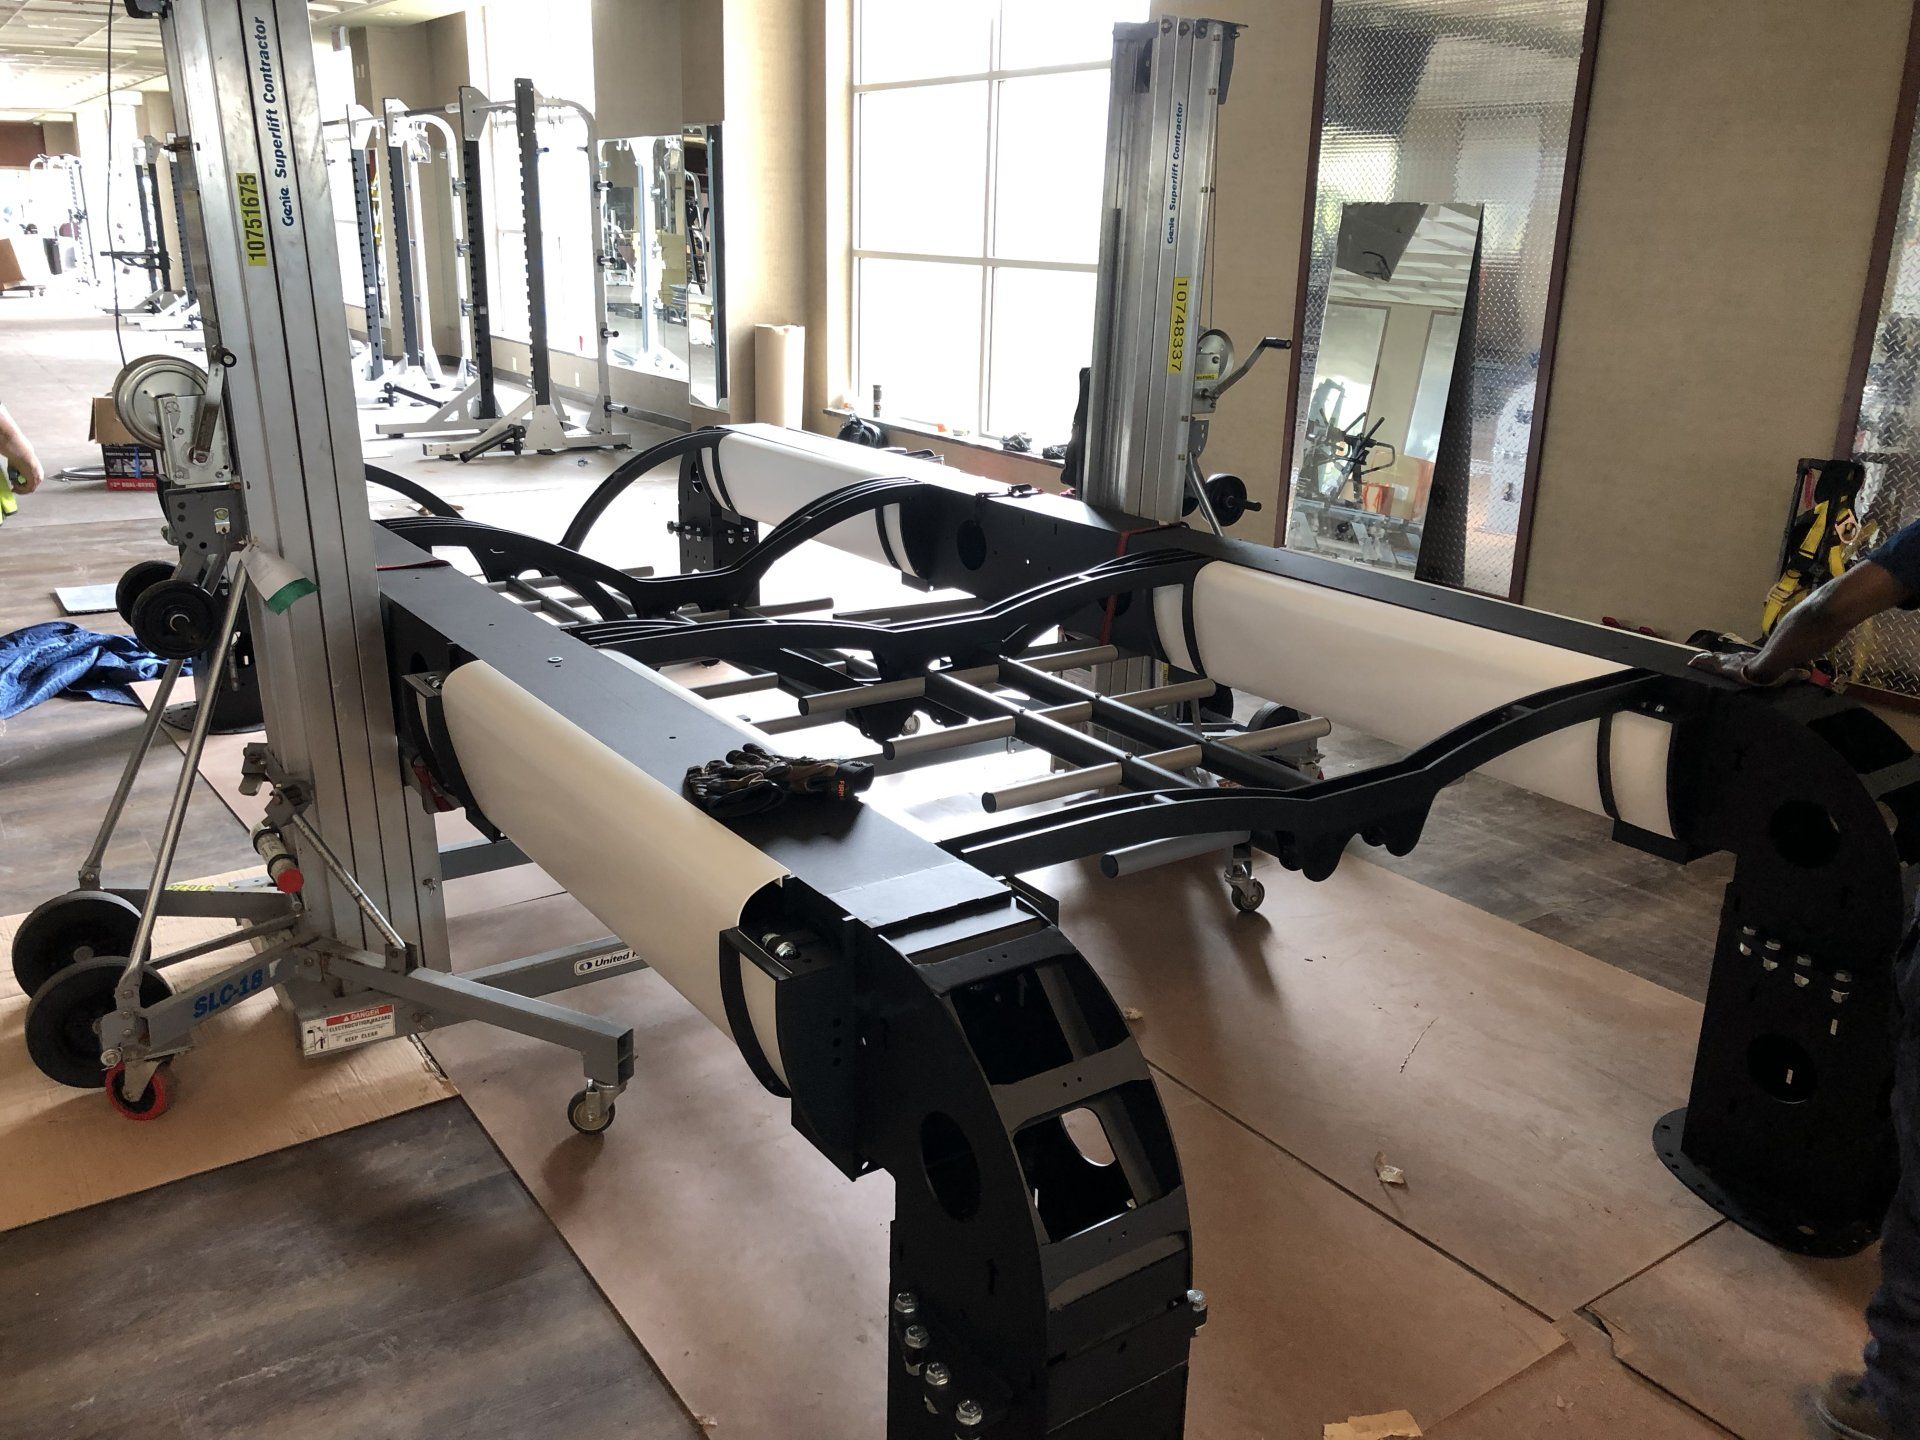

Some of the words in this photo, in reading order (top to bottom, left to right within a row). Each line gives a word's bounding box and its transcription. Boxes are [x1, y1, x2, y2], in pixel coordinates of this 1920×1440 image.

[254, 16, 276, 104] Contractor
[269, 108, 287, 179] Superlift
[1172, 101, 1184, 160] Contractor
[282, 186, 295, 227] Genie
[1169, 163, 1179, 211] Superlift
[237, 174, 267, 262] 10751675
[1167, 217, 1175, 244] Genie
[1171, 280, 1188, 372] 10748337
[595, 951, 630, 967] United
[192, 968, 264, 1018] SLC-18
[350, 1008, 380, 1021] DANGER
[344, 1034, 359, 1043] KEEP
[361, 1030, 379, 1038] CLEAR
